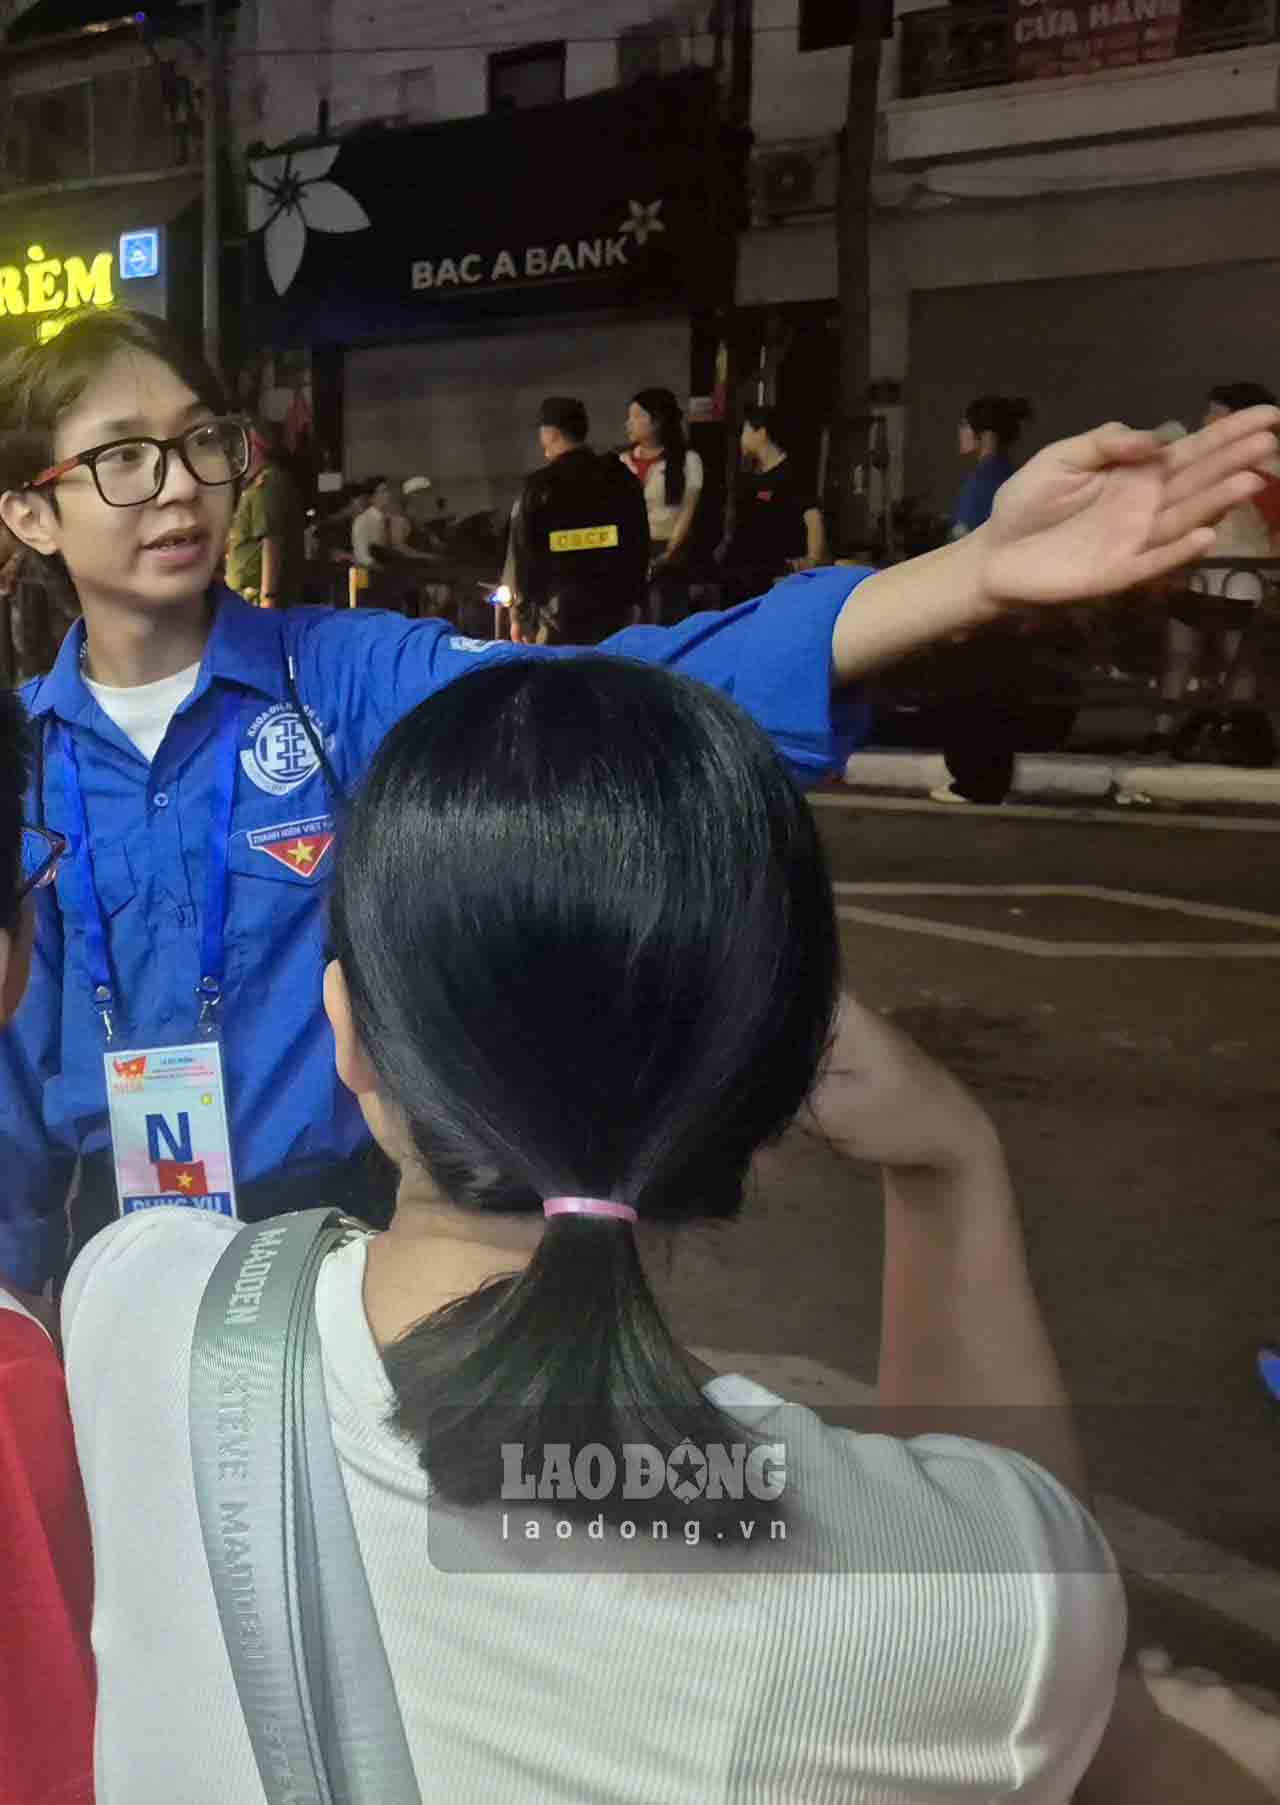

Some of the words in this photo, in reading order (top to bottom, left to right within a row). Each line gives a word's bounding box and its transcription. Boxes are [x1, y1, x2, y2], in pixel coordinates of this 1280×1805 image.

[411, 253, 482, 290] BAC
[491, 251, 518, 280] A
[525, 235, 629, 276] BANK
[145, 1111, 193, 1163] N
[224, 1227, 288, 1325] MADDEN
